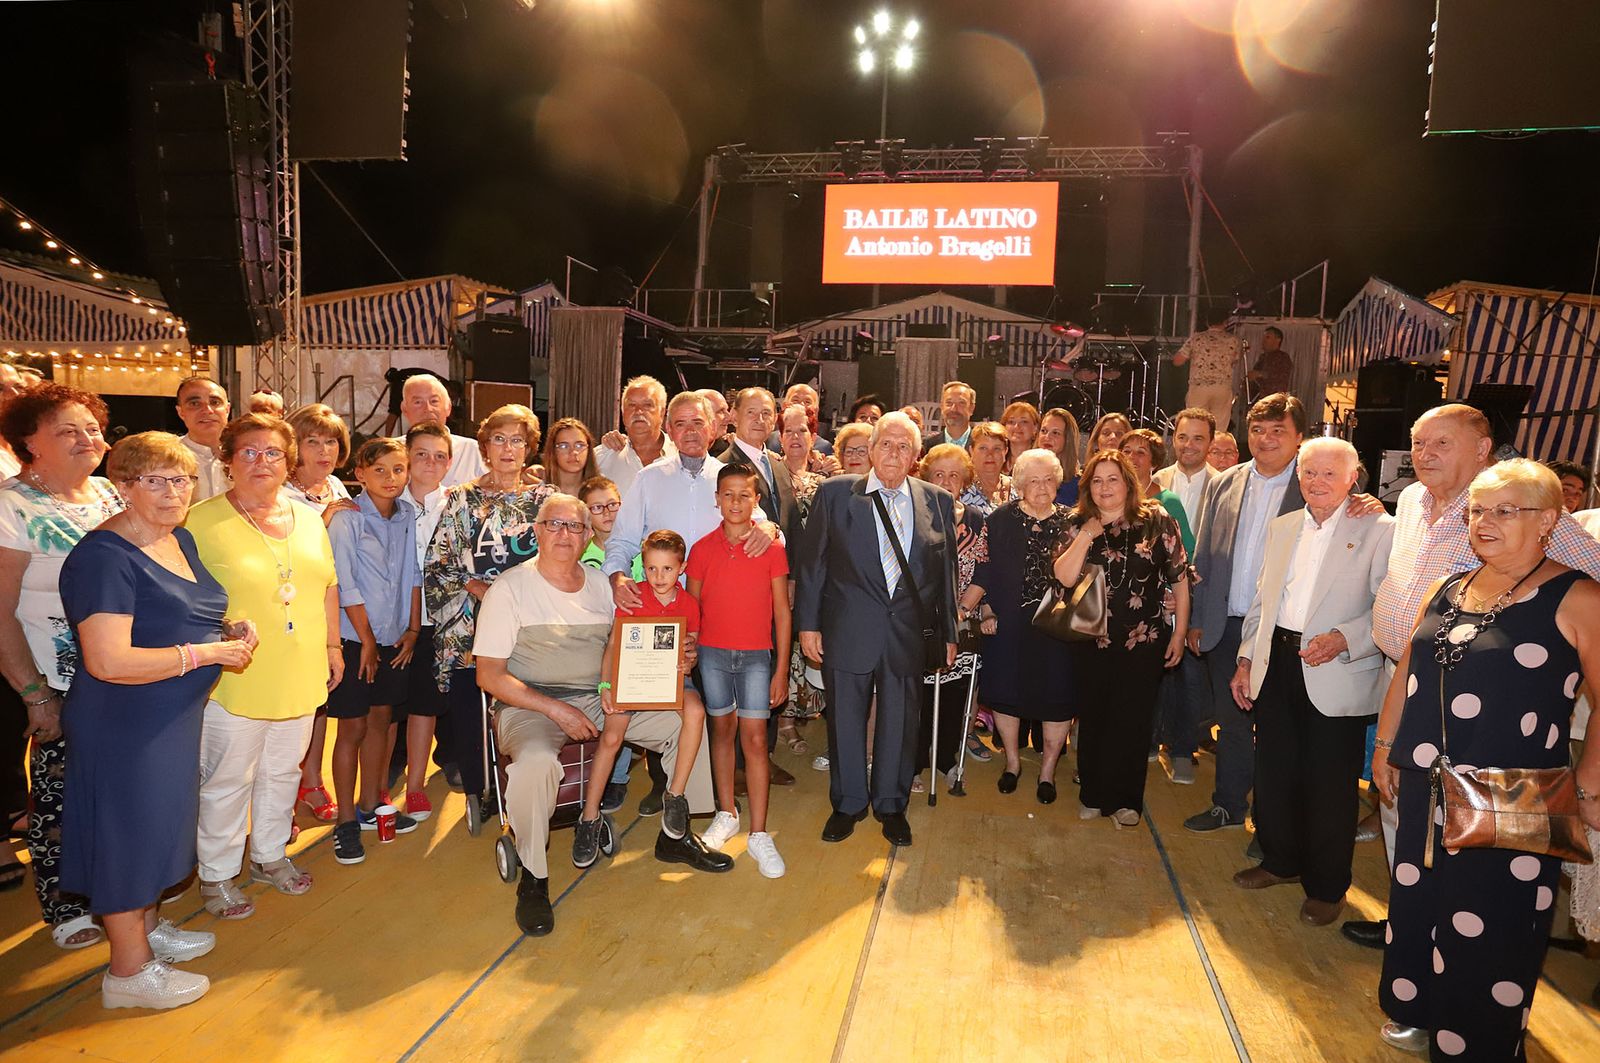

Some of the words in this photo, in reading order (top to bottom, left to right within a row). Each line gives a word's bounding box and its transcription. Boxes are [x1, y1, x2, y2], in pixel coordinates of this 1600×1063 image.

[843, 208, 928, 229] BAILE
[934, 208, 1037, 229] LATINO
[845, 236, 933, 256] Antonio
[939, 236, 1032, 261] Bragelli
